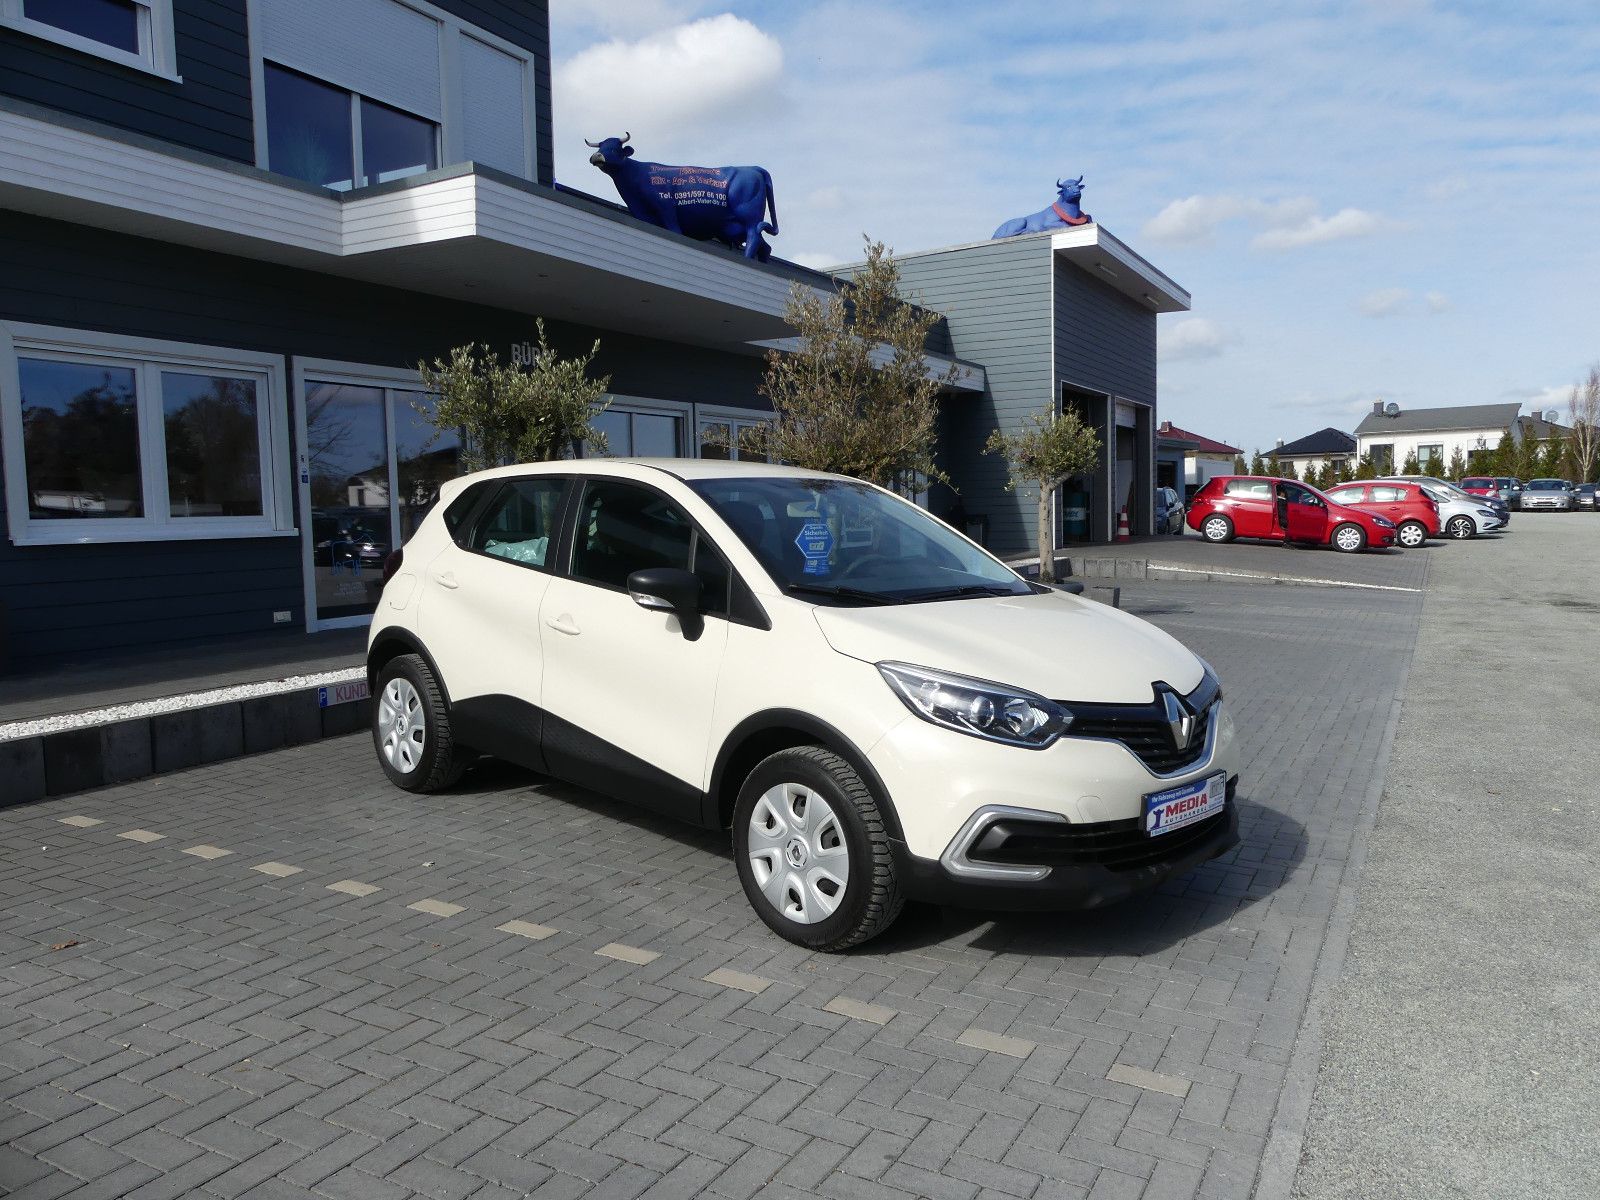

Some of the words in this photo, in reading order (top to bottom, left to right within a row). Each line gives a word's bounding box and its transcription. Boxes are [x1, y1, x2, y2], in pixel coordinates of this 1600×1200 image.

[715, 193, 727, 201] 100
[335, 681, 371, 703] KUND
[1165, 793, 1208, 818] MEDIA
